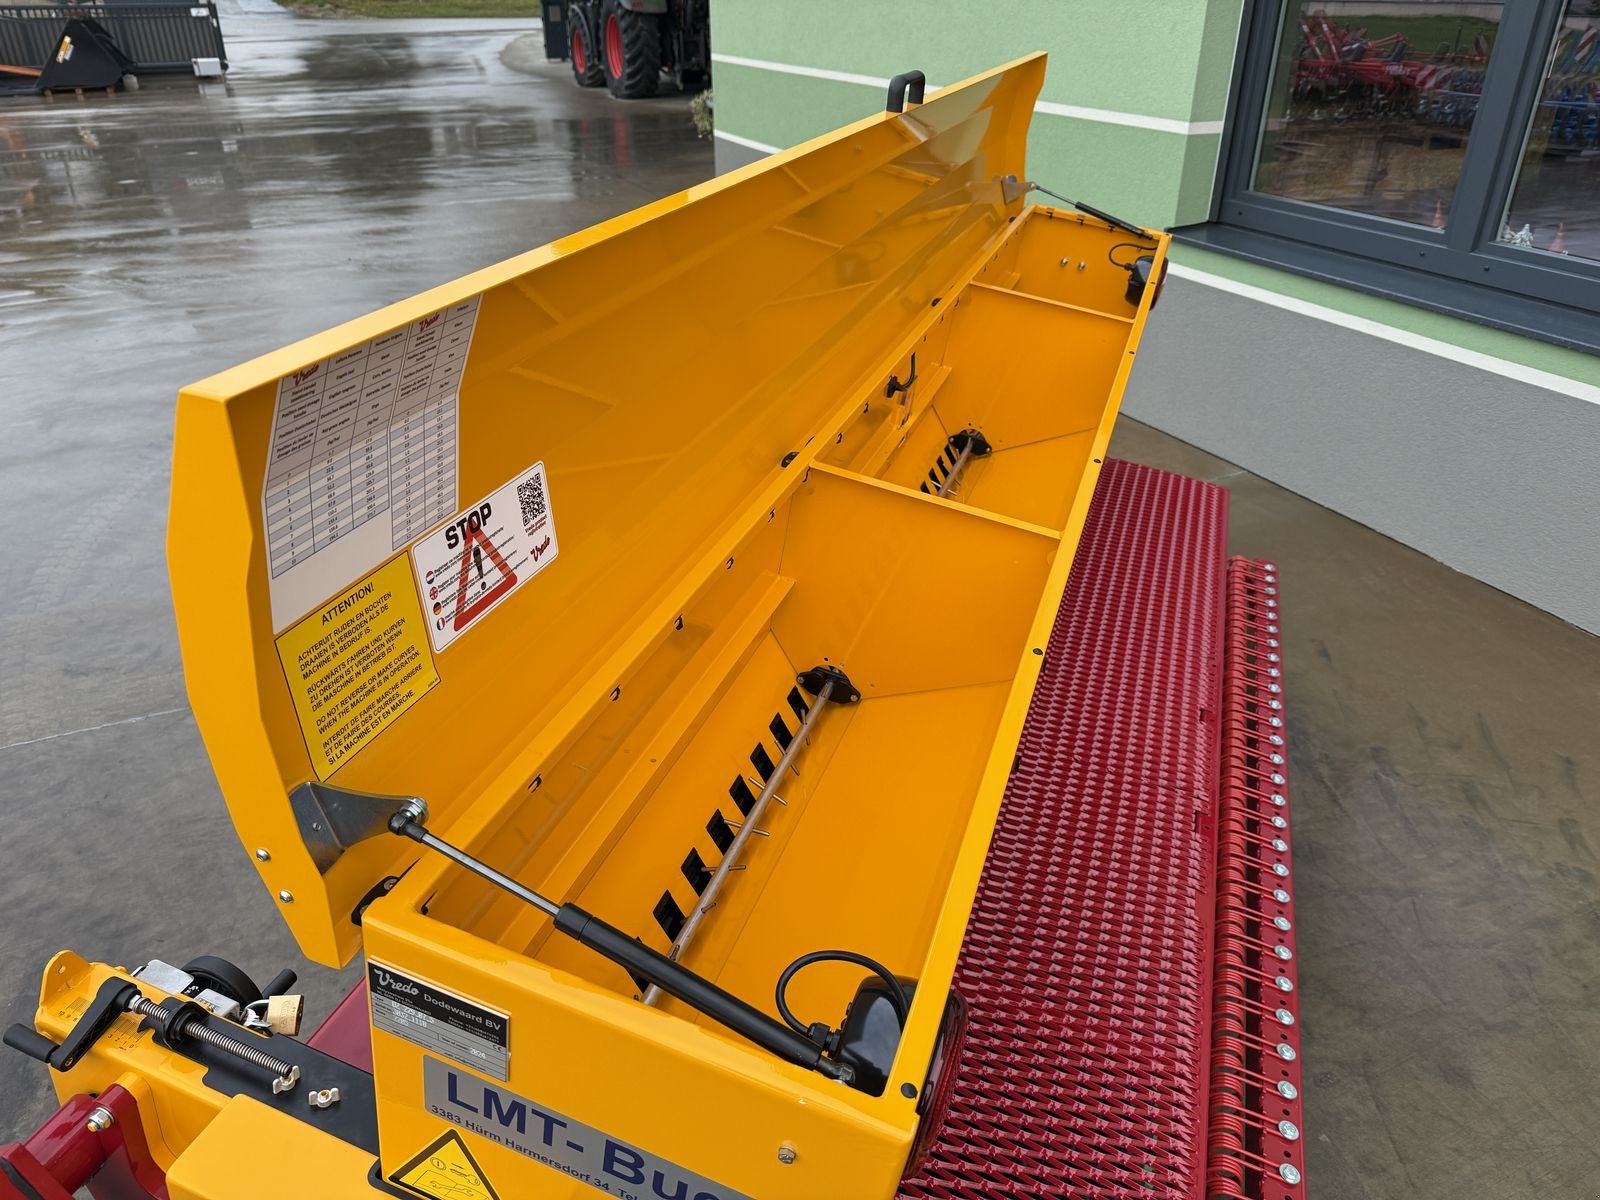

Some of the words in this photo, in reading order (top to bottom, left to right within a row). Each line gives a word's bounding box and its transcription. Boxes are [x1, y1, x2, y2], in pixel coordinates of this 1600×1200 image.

[445, 502, 492, 550] STOP
[530, 535, 550, 561] Vredo
[297, 633, 333, 663] ACHTERUIT
[333, 617, 355, 637] RIJDEN
[355, 610, 364, 620] EN
[364, 590, 391, 614] BOCHTEN
[299, 646, 328, 672] DRAAIEN
[328, 641, 335, 650] IS
[335, 618, 368, 645] VERBODEN
[368, 609, 380, 622] ALS
[380, 603, 388, 613] DE
[320, 581, 374, 625] ATTENTION!
[302, 654, 331, 680] MACHINE
[331, 649, 338, 659] IN
[339, 630, 364, 653] BEDRIJF
[364, 625, 372, 635] IS.
[306, 660, 346, 695] RÜCKWÄRTS
[346, 643, 370, 665] FAHREN
[370, 633, 382, 647] UND
[383, 616, 405, 638] KURVEN
[309, 692, 318, 703] ZU
[319, 672, 344, 696] DREHEN
[344, 665, 354, 676] IST
[354, 641, 385, 669] VERBOTEN
[385, 628, 402, 645] WENN
[311, 699, 322, 712] DIE
[323, 675, 354, 703] MASCHINE
[354, 669, 361, 678] IN
[361, 650, 386, 673] BETRIEB
[386, 642, 396, 654] IST.
[316, 714, 326, 726] DO
[326, 703, 339, 718] NOT
[340, 682, 367, 708] REVERSE
[367, 674, 376, 686] OR
[376, 661, 393, 678] MAKE
[393, 644, 415, 665] CURVES
[318, 715, 337, 734] WHEN
[338, 705, 350, 719] THE
[350, 684, 376, 709] MACHINE
[376, 679, 382, 688] IS
[383, 674, 389, 683] IN
[389, 648, 420, 678] OPERATION.
[322, 722, 349, 749] INTERDIT
[350, 715, 358, 726] DE
[359, 701, 376, 719] FAIRE
[376, 682, 399, 705] MARCHE
[324, 746, 333, 757] ET
[334, 738, 342, 750] DE
[343, 723, 360, 742] FAIRE
[360, 713, 372, 727] DES
[373, 690, 401, 718] COURBES,
[328, 754, 335, 765] SI
[335, 747, 344, 759] LA
[344, 725, 371, 751] MACHINE
[370, 716, 381, 729] EST
[382, 708, 390, 720] EN
[390, 687, 415, 712] MARCHE.
[374, 968, 419, 996] Vredo
[424, 993, 482, 1024] Dodewaard
[485, 1018, 500, 1031] BV
[431, 1105, 462, 1124] 3383
[466, 1120, 501, 1142] Hürm
[506, 1138, 590, 1182] Harmersdorf
[594, 1178, 610, 1191] 34
[448, 1071, 584, 1152] LMT-
[602, 1140, 718, 1200] Bu
